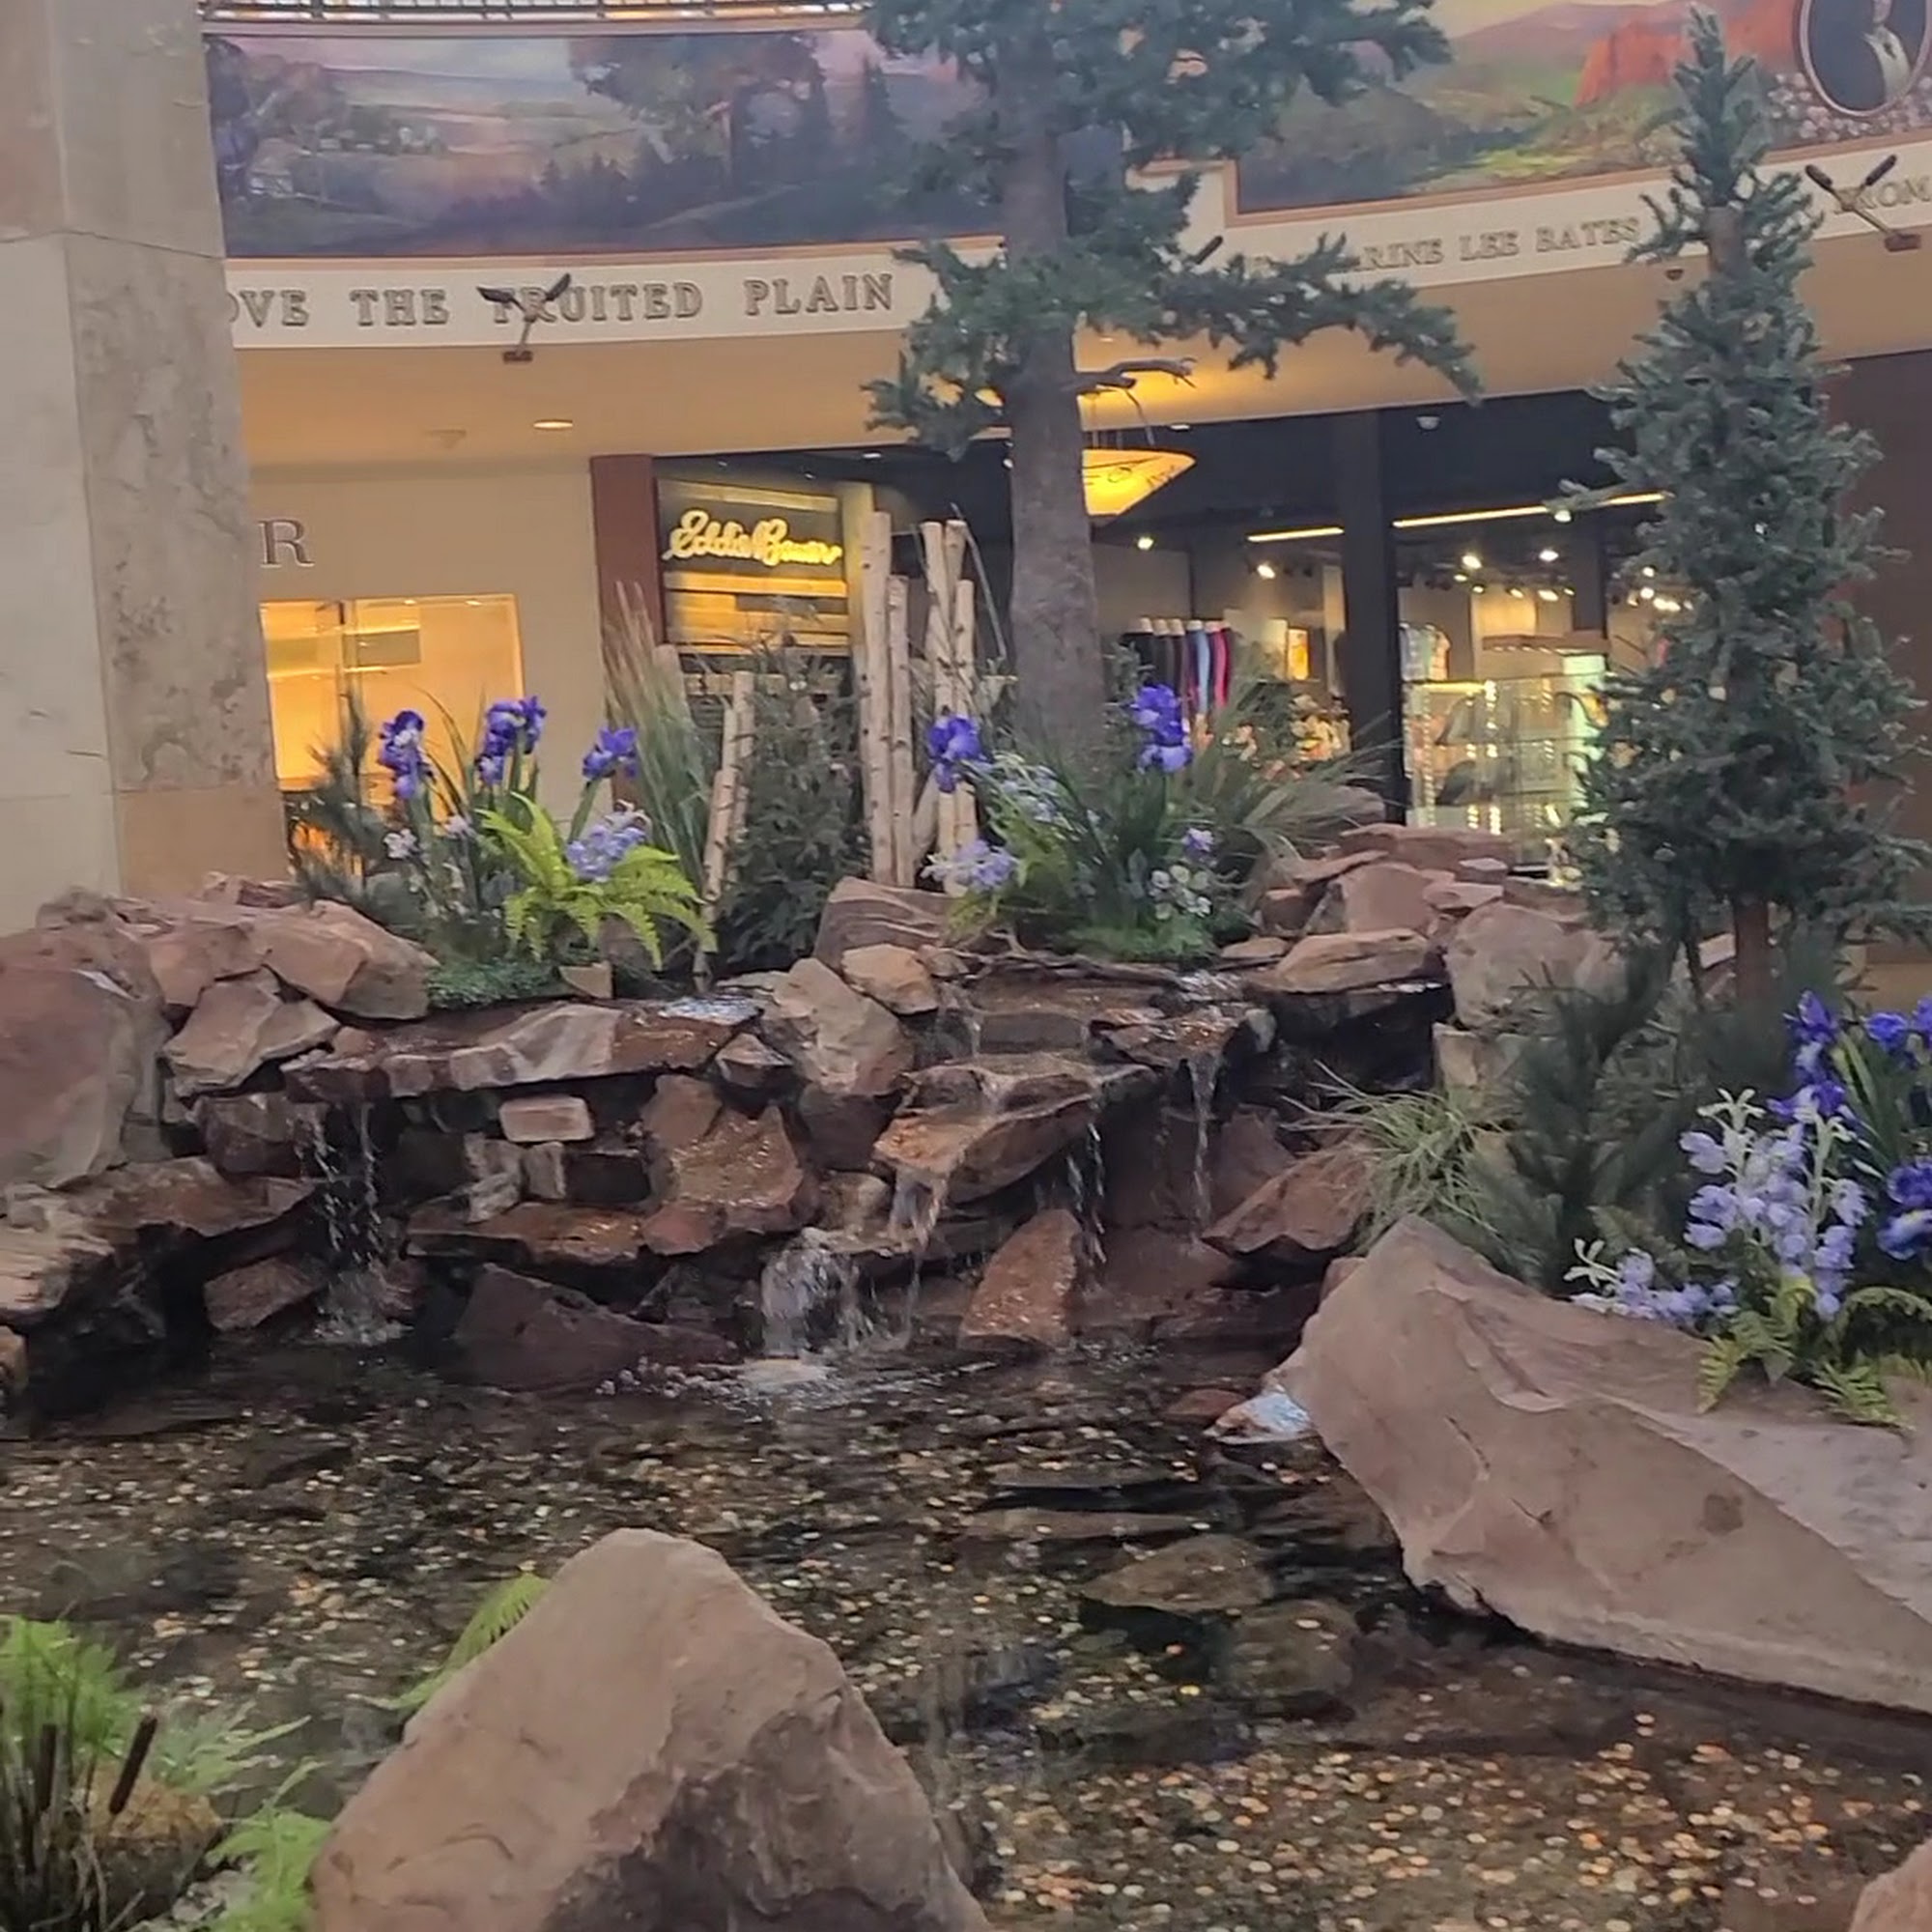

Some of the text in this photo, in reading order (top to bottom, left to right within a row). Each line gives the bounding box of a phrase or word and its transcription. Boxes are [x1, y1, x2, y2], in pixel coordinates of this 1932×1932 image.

[1459, 230, 1520, 263] LEE
[1536, 216, 1640, 254] BATES
[349, 288, 450, 327] THE
[743, 272, 893, 317] PLAIN
[257, 519, 316, 568] R
